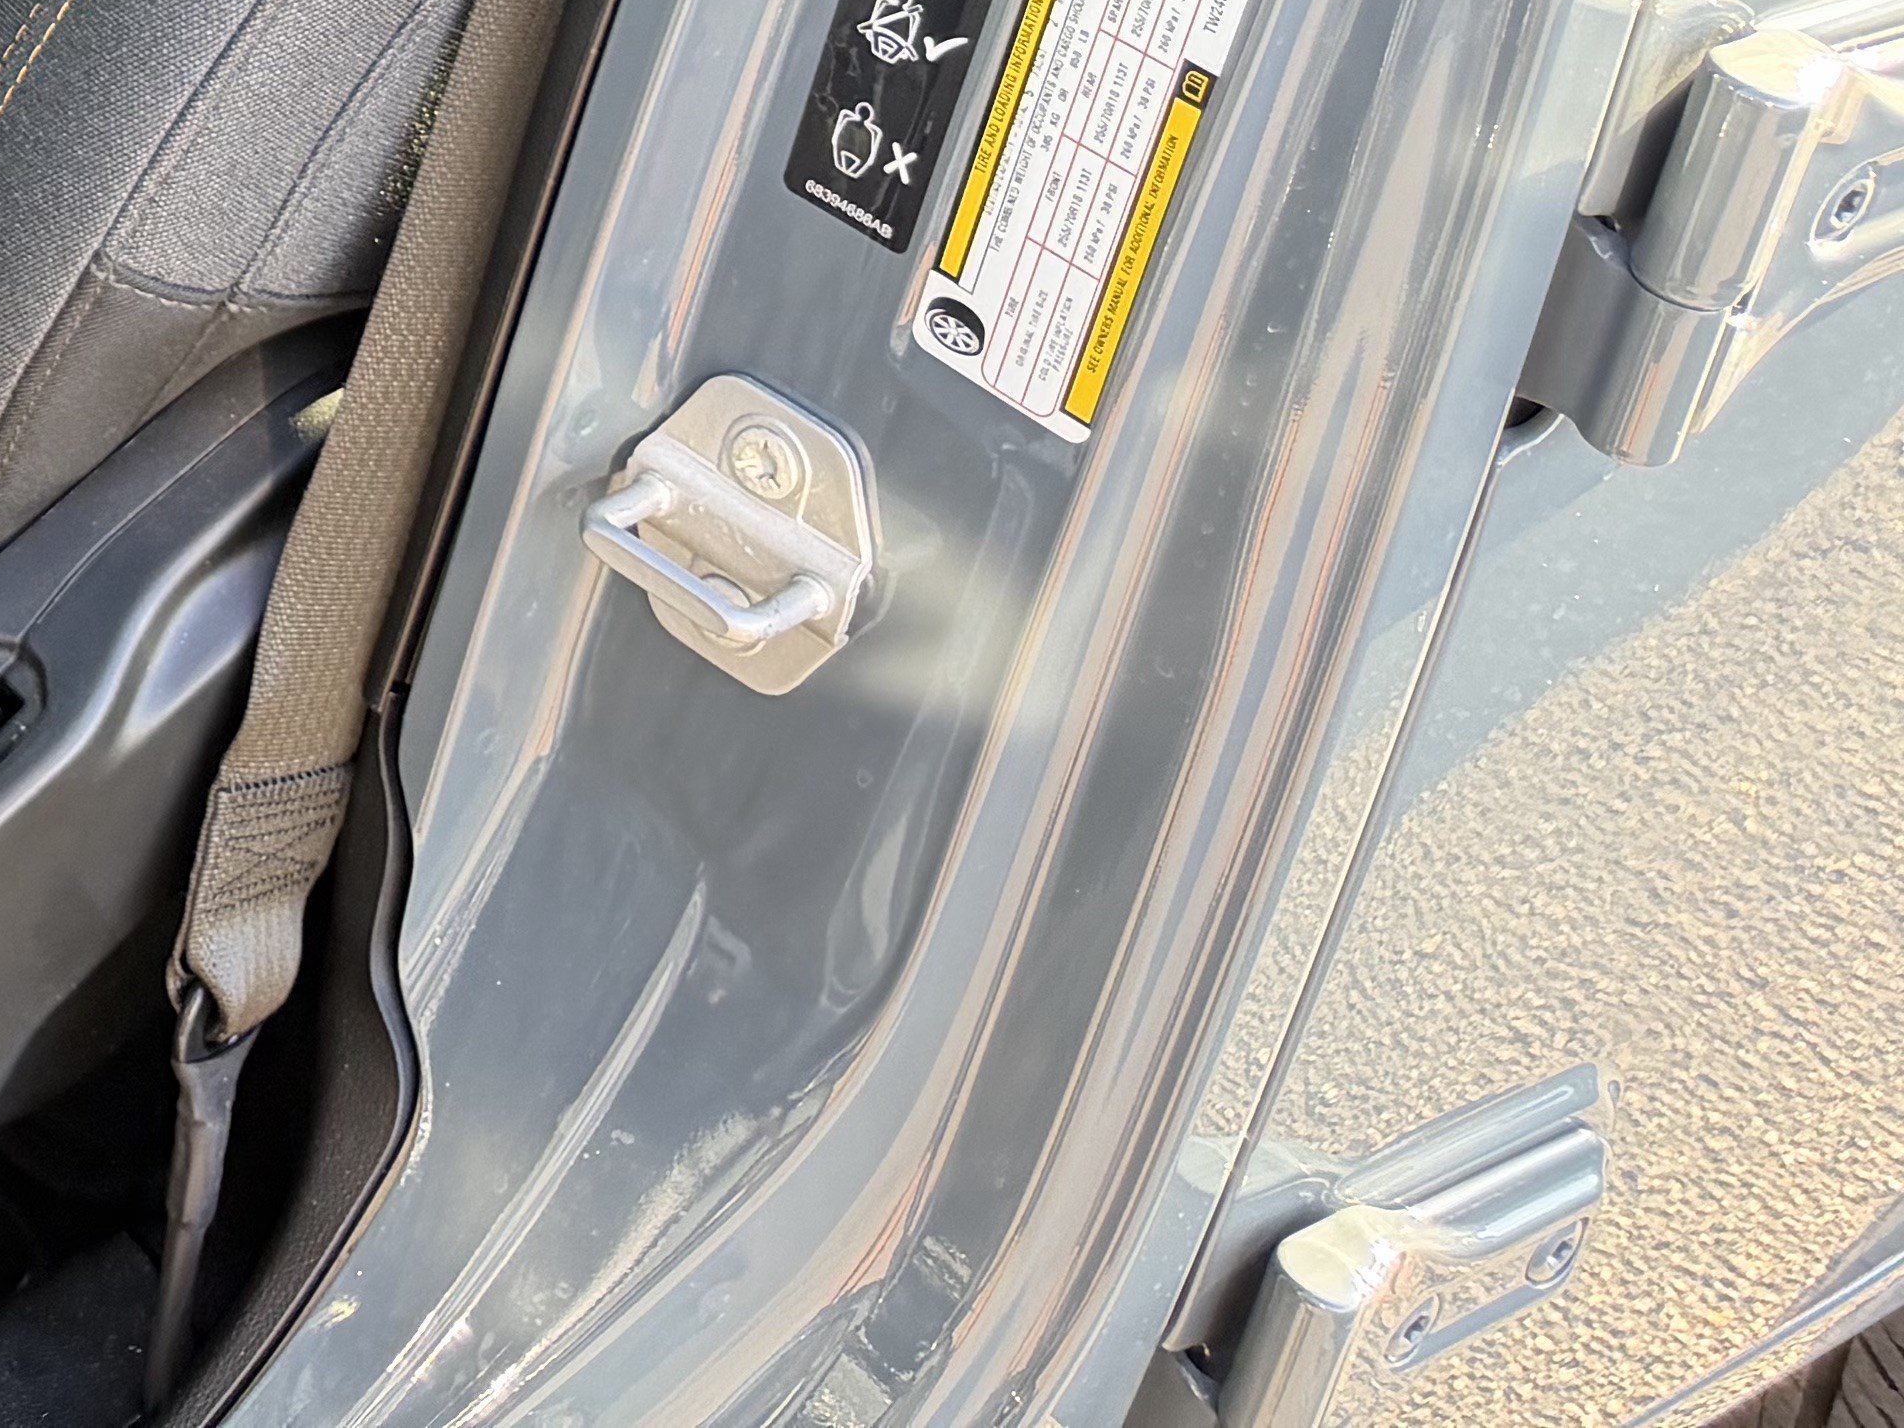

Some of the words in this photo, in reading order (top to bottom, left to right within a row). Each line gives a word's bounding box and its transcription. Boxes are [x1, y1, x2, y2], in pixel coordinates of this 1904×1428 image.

[1055, 23, 1075, 58] CARGO
[1048, 56, 1064, 79] AND
[991, 71, 1017, 123] LOADING
[1029, 78, 1056, 134] OCCUPANTS
[983, 121, 1000, 148] AND
[1024, 134, 1037, 149] OF
[974, 147, 992, 175] TIRE
[1147, 132, 1178, 199] INFORMATION
[1127, 198, 1155, 254] ADDITIONAL
[1120, 254, 1135, 275] FOR
[1106, 275, 1128, 315] MANUAL
[1085, 354, 1100, 374] SEE
